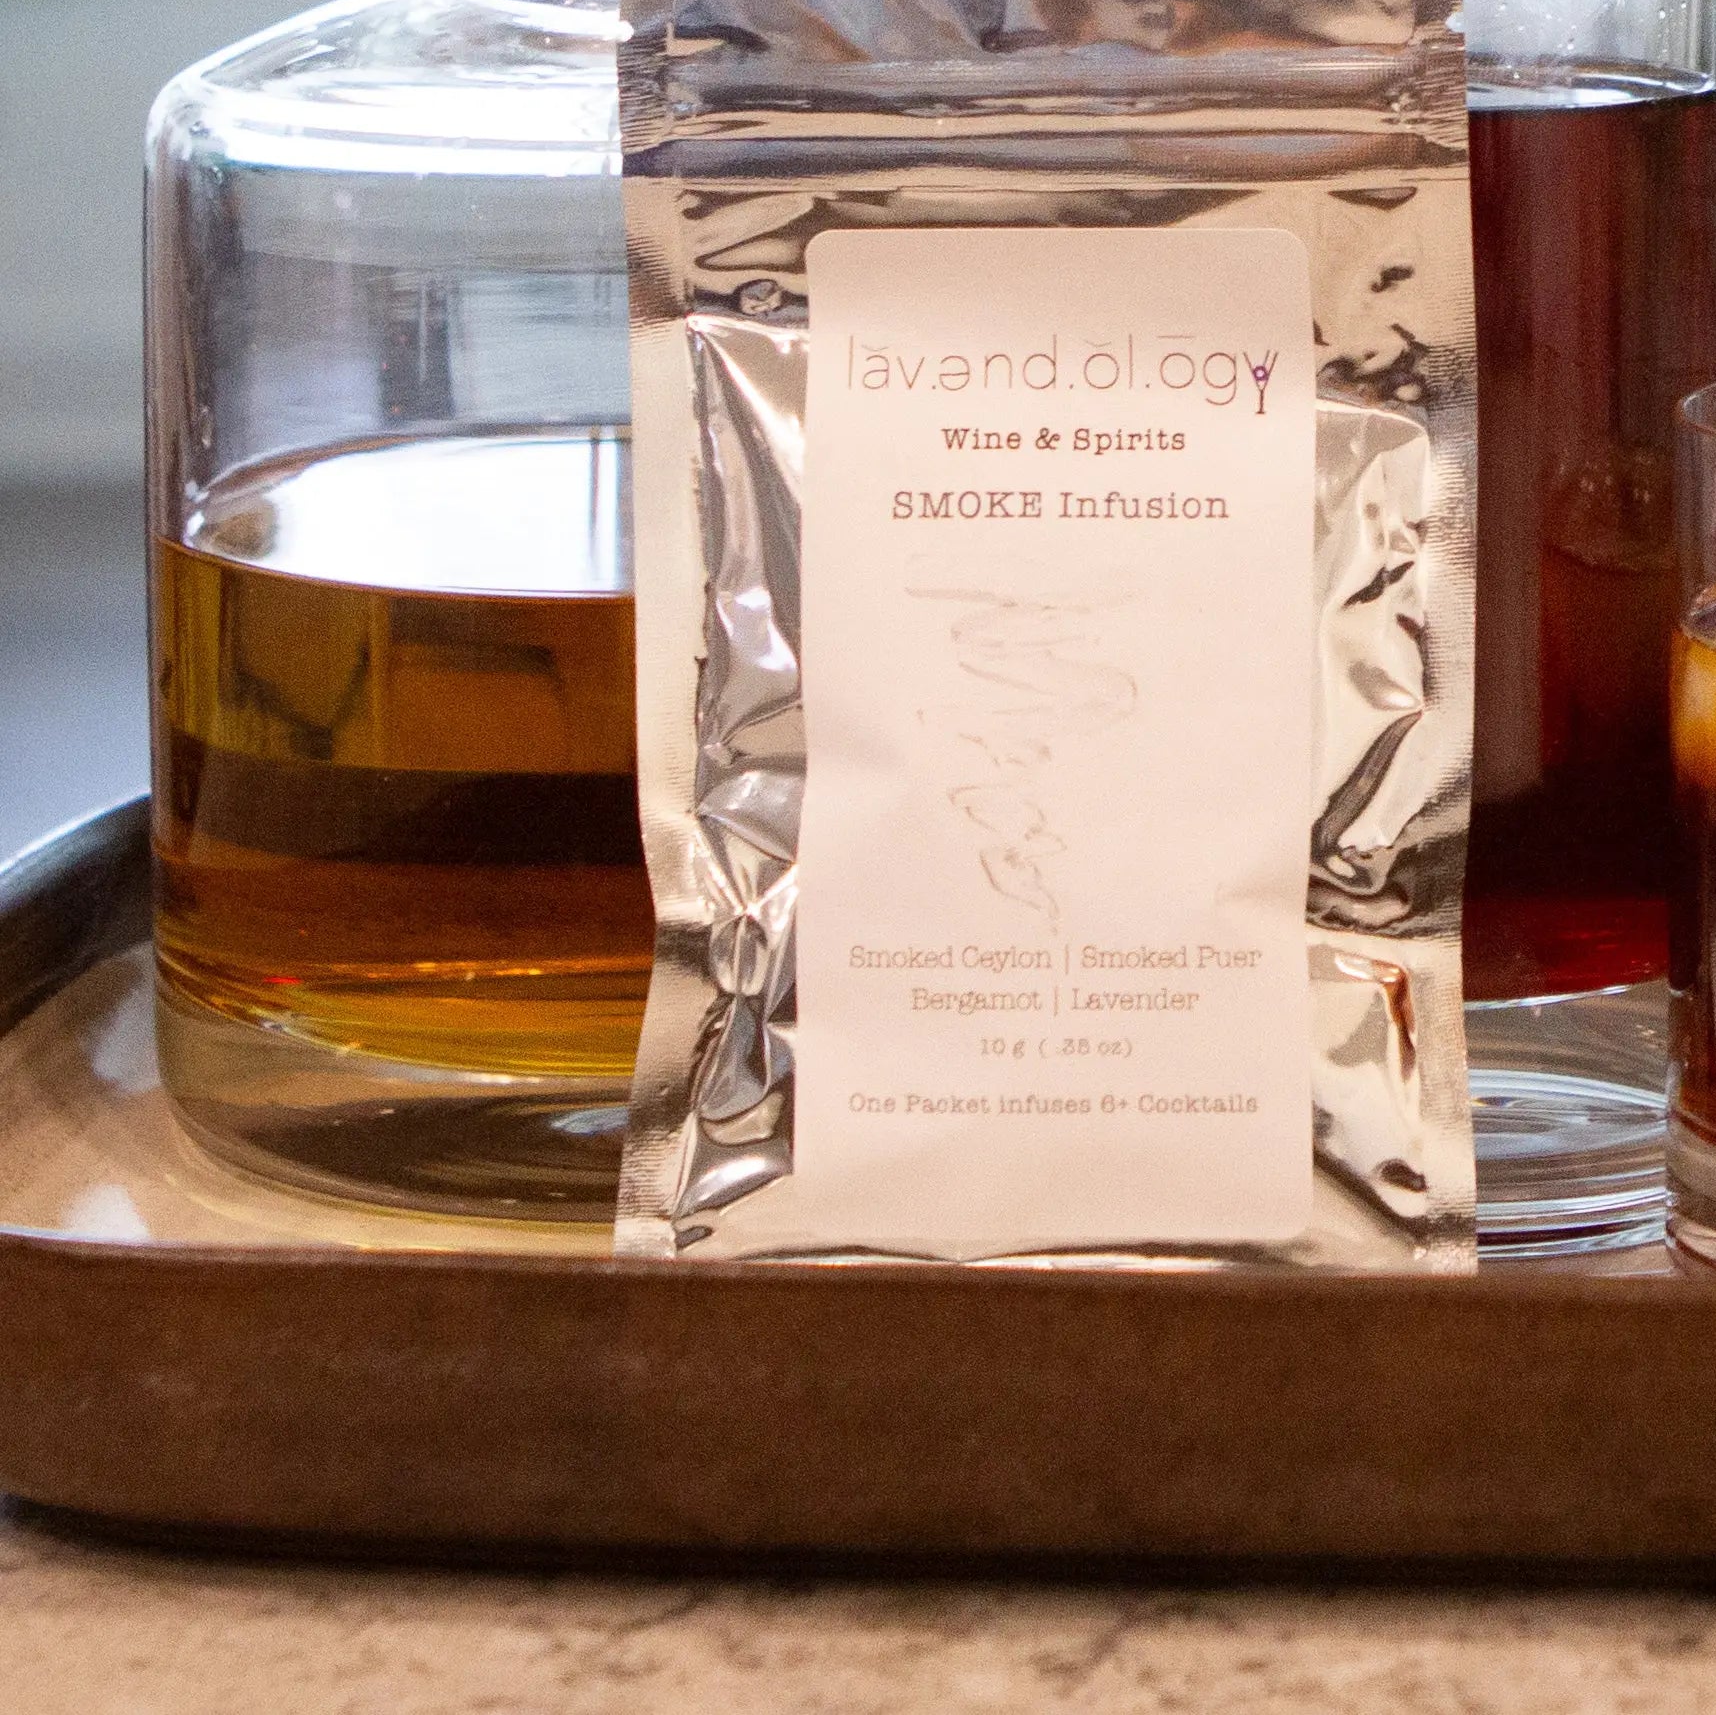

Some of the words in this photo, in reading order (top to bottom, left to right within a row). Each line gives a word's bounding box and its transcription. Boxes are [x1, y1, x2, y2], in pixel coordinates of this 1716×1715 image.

[941, 428, 1022, 451] Wine
[1034, 429, 1060, 451] &
[1072, 427, 1186, 455] Spirits
[892, 491, 1043, 520] SMOKE
[1058, 490, 1230, 520] Infusion
[848, 944, 954, 970] Smoked
[961, 944, 1052, 974] Ceylon
[1081, 944, 1188, 970] Smoked
[1197, 946, 1263, 970] Puer
[911, 987, 1042, 1016] Bergamot
[1071, 987, 1200, 1012] Lavender
[980, 1037, 1004, 1057] 10
[849, 1093, 896, 1114] One
[905, 1093, 990, 1115] Packet
[1100, 1093, 1129, 1115] 6+
[1138, 1093, 1258, 1115] Cocktails
